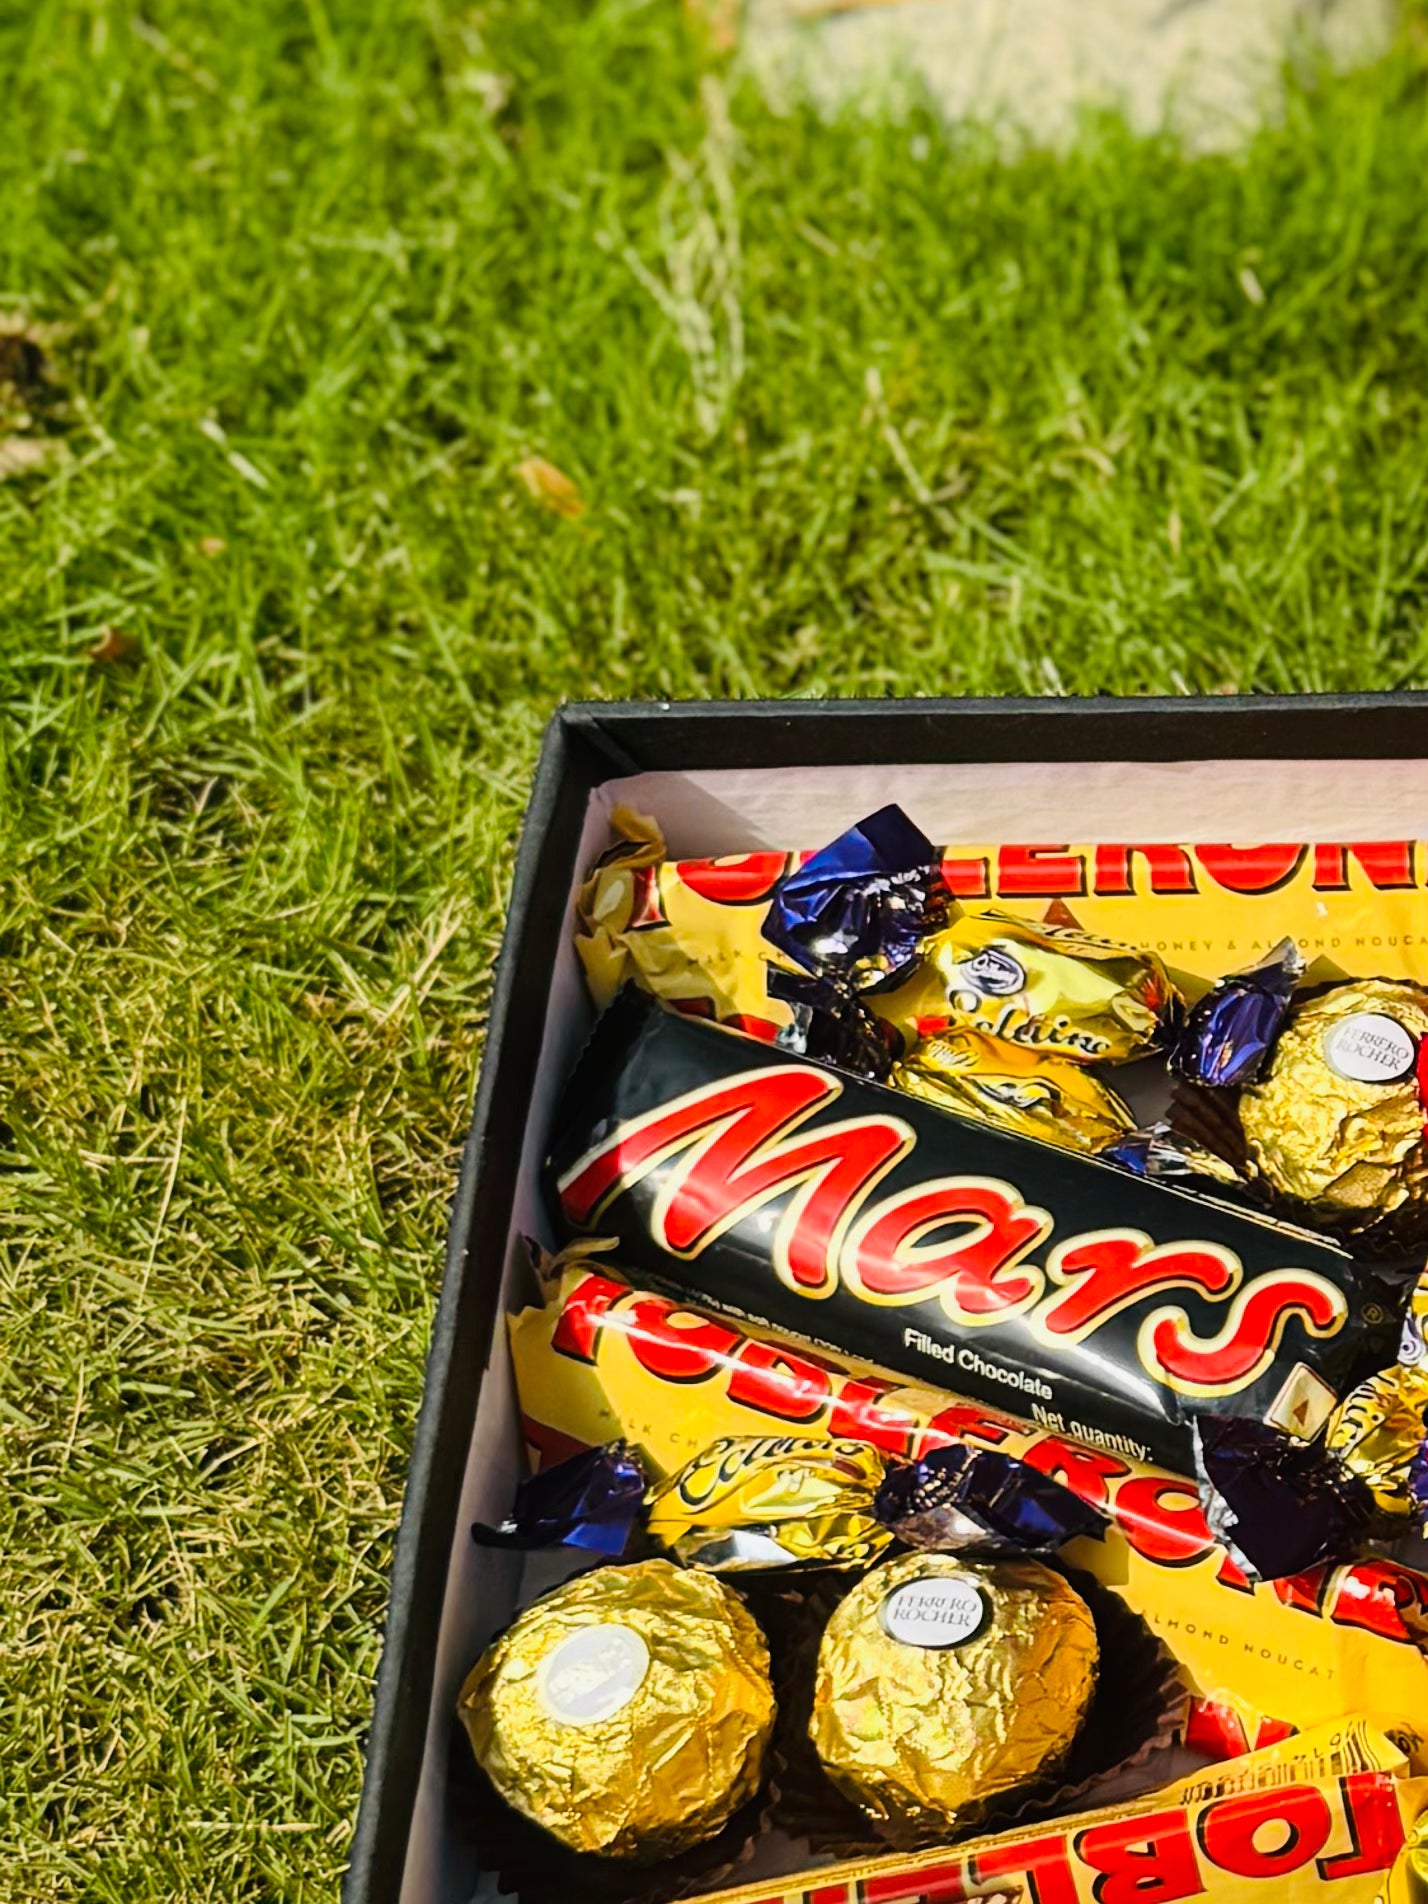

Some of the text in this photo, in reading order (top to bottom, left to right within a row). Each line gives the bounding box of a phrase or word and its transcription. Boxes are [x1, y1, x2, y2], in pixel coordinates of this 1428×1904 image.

[1250, 936, 1342, 951] ALOND
[1335, 1039, 1402, 1072] ROCHER
[1342, 1025, 1411, 1061] FERRERO
[558, 1065, 1351, 1400] Mars
[904, 1327, 1054, 1401] Filled Chocolate
[1031, 1402, 1155, 1463] Net quantity:
[892, 1608, 974, 1629] ROCHER
[895, 1595, 979, 1616] FERRERO
[1243, 1642, 1338, 1681] NOUGAT
